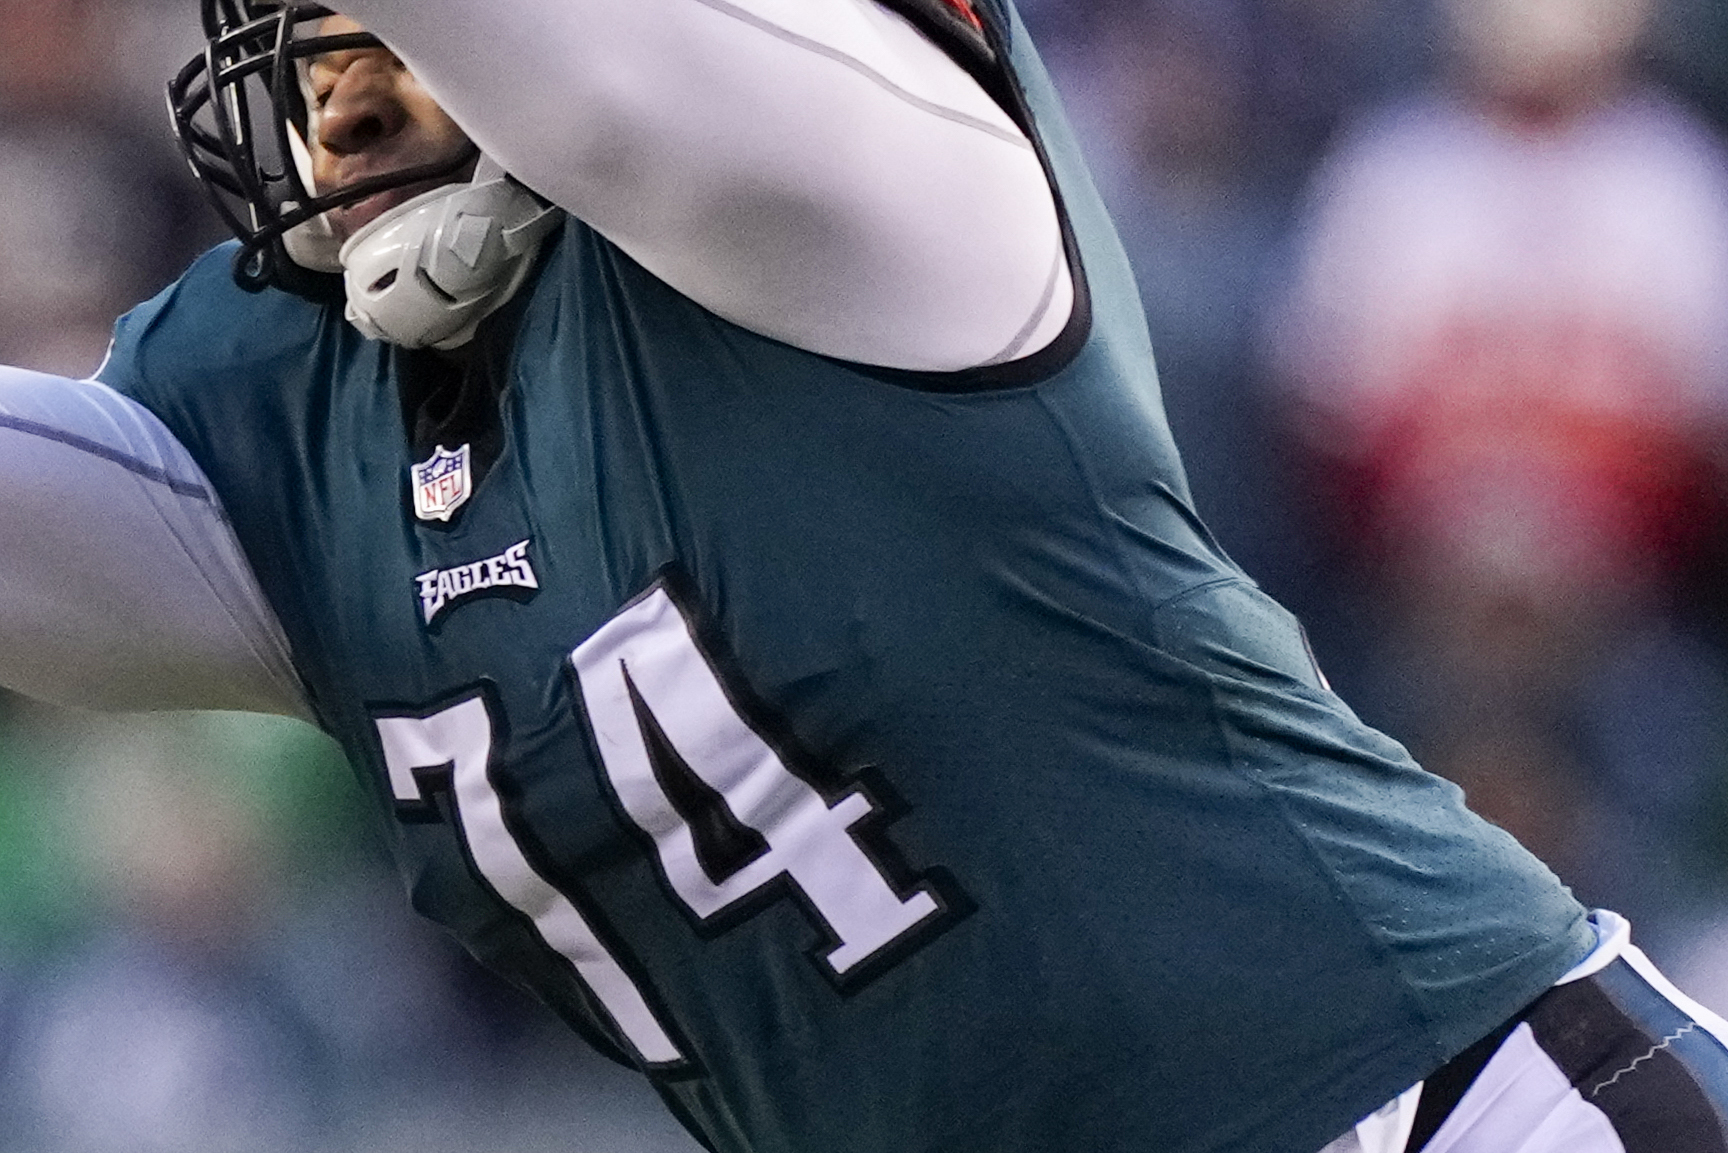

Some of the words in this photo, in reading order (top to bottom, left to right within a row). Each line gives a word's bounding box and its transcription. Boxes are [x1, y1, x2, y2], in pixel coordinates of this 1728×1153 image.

[423, 474, 462, 509] NFL
[415, 539, 540, 626] EAGLES
[369, 580, 947, 1068] 74
